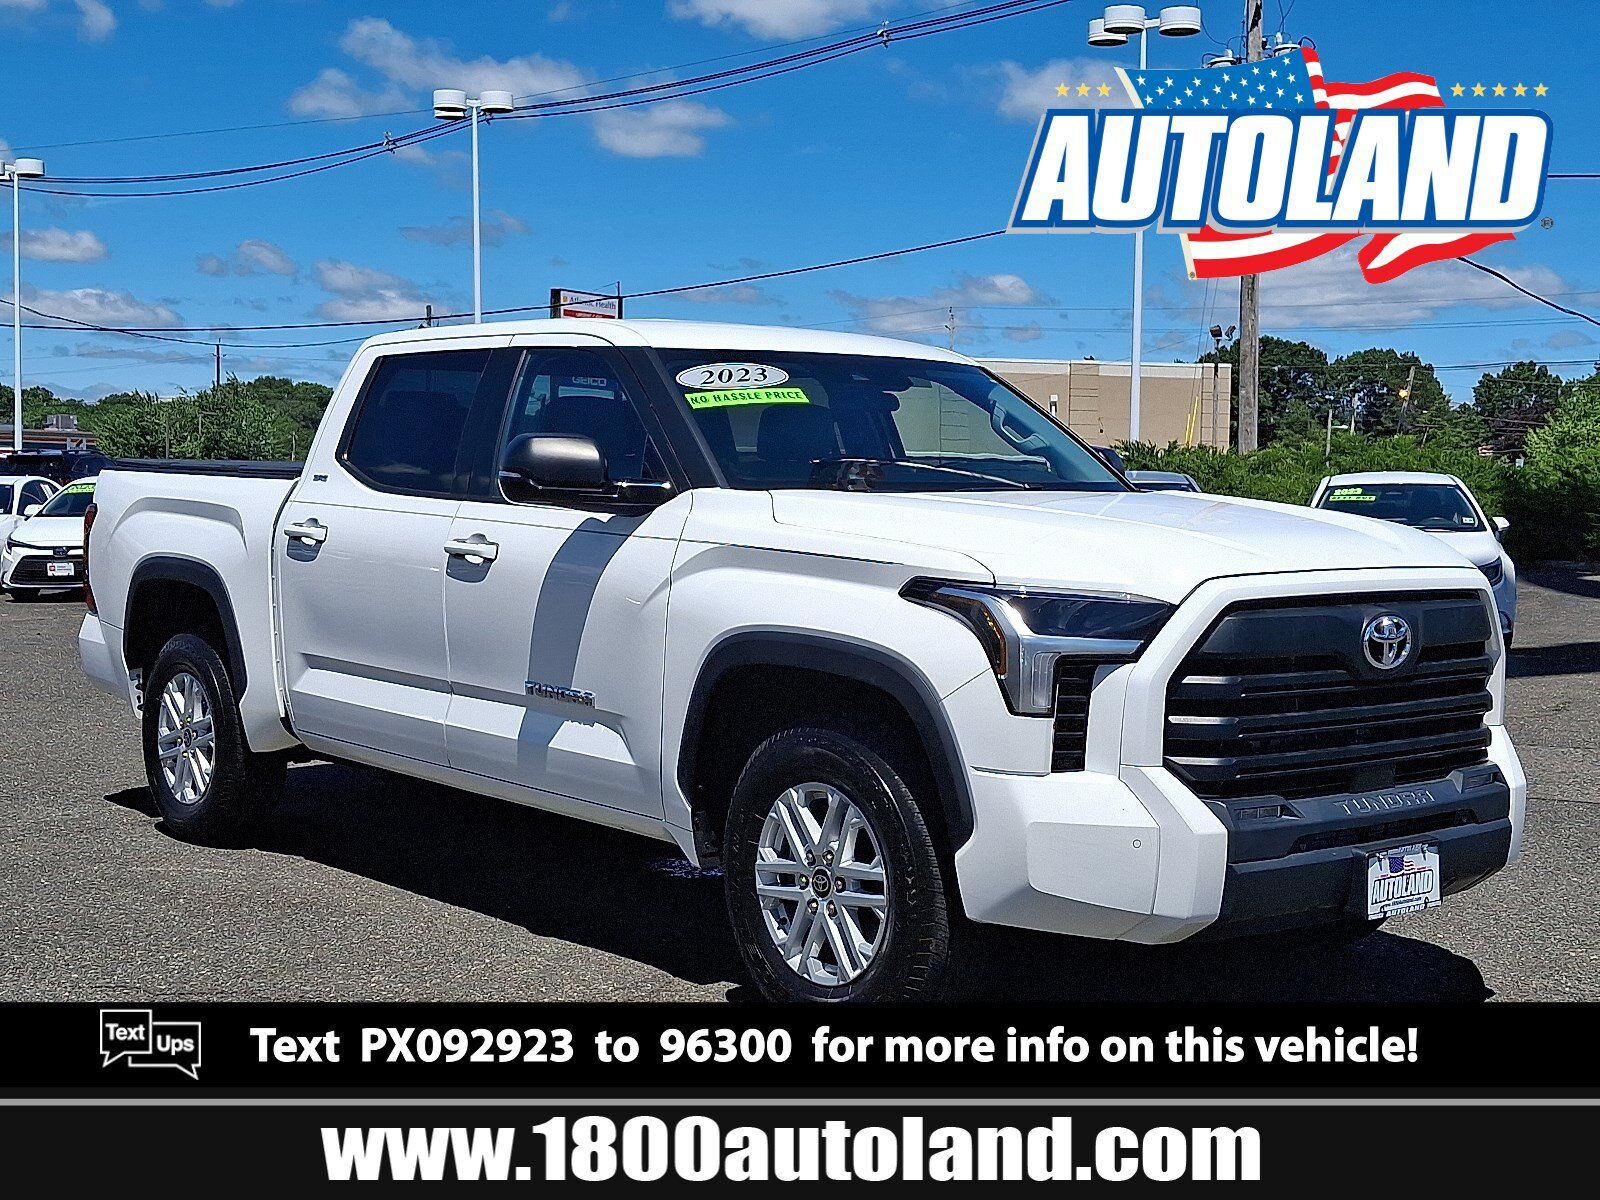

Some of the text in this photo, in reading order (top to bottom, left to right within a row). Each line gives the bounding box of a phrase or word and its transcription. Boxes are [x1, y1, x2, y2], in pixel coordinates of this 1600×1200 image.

[595, 300, 616, 310] Health
[571, 376, 607, 387] GEICO
[700, 367, 768, 386] 2023
[690, 390, 805, 405] NO HASSLE PRICE
[1333, 789, 1435, 815] TUNDRA
[1371, 871, 1434, 905] AUTOLAND
